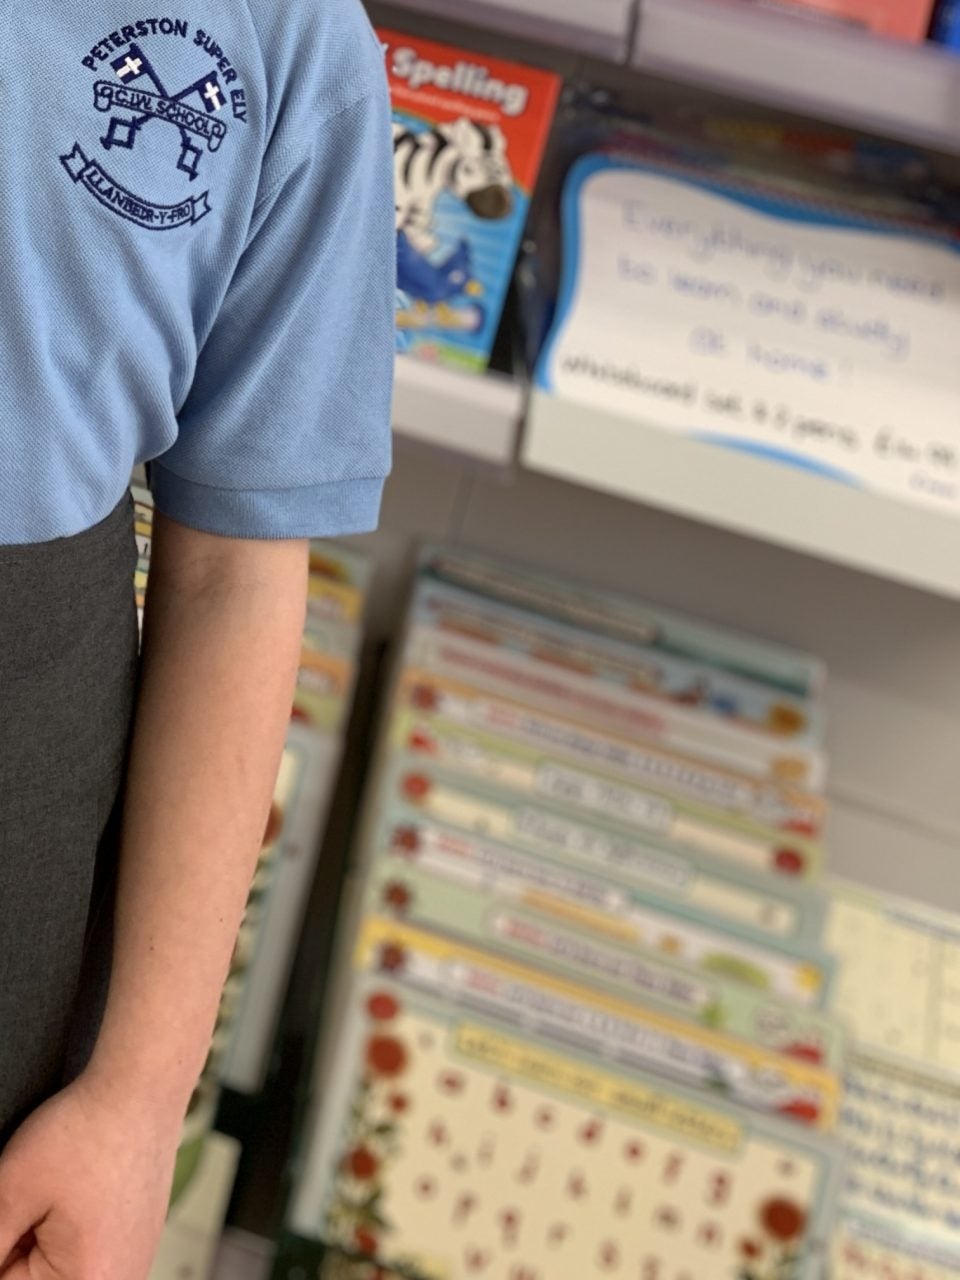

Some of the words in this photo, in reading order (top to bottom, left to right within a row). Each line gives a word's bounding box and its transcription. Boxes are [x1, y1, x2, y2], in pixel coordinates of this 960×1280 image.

[81, 18, 188, 72] PETERSTON
[193, 29, 238, 84] SUPER
[230, 88, 247, 124] ELY
[392, 47, 528, 116] Spelling
[155, 100, 210, 135] SCHOOL
[85, 169, 191, 225] LLANBEDR-Y-FRO
